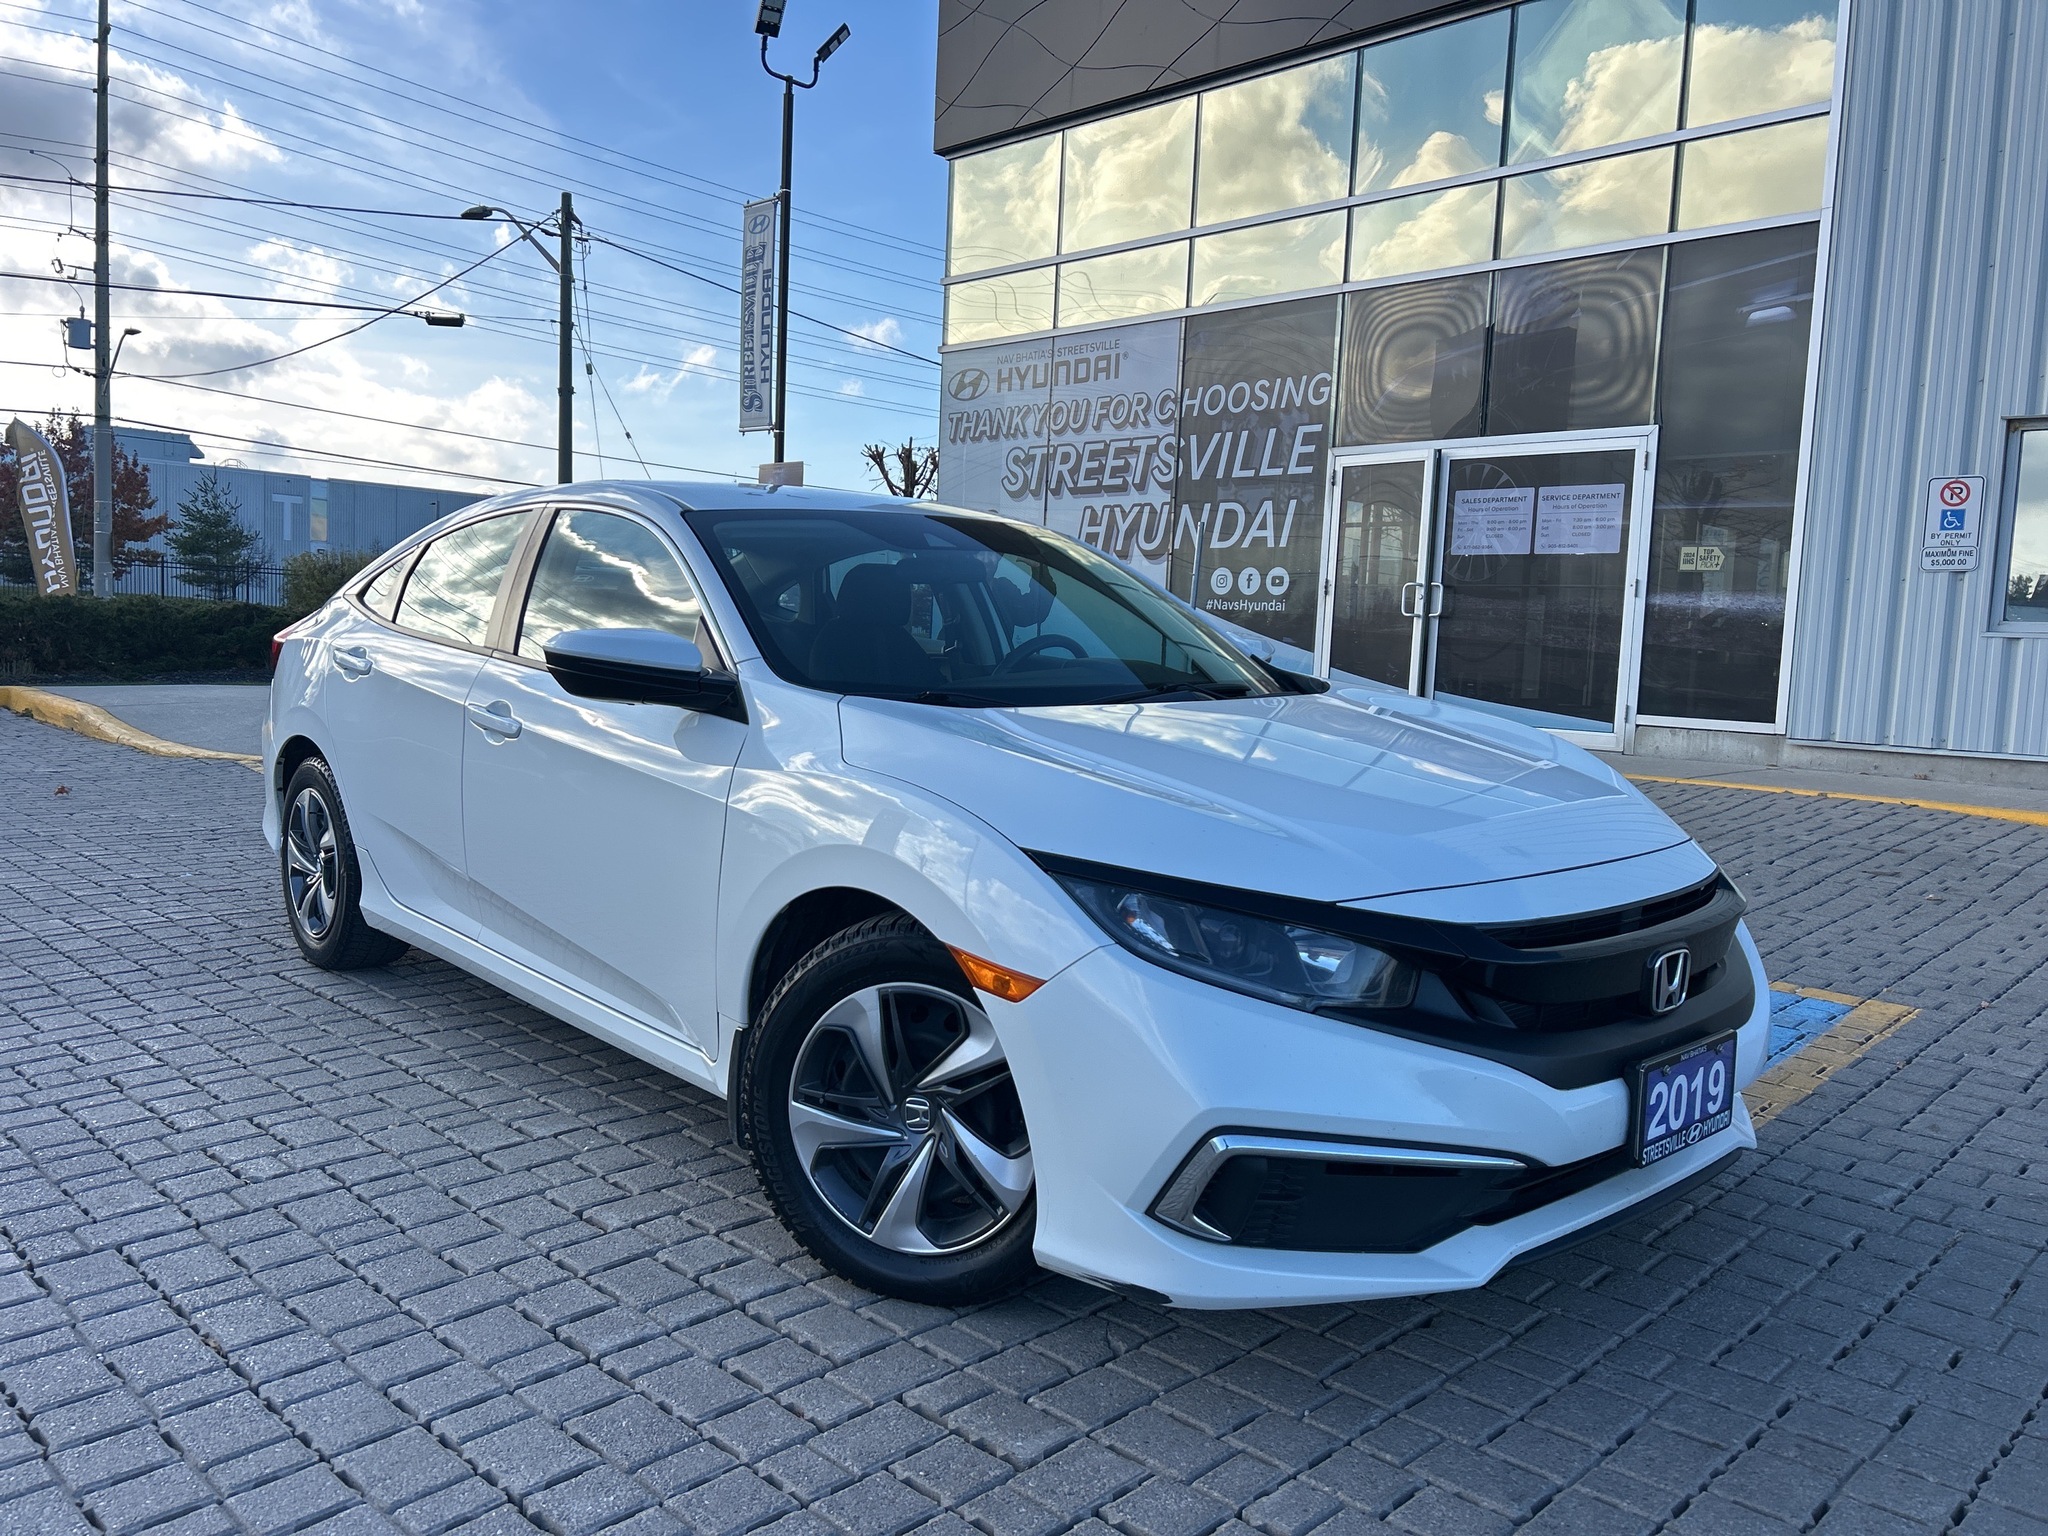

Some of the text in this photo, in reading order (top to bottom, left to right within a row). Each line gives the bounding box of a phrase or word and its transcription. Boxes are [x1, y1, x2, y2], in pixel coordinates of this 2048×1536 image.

[760, 268, 772, 383] HYUNDAI
[996, 353, 1120, 393] HYUNDAI
[997, 339, 1120, 365] NAV BHATIA'S STREETSVILLE
[947, 372, 1332, 443] THANK YOU FOR CHOOSING
[1001, 423, 1323, 496] STREETSVILLE
[1483, 495, 1528, 503] DEPARTMENT
[1572, 492, 1621, 500] DEPARTMENT
[1080, 499, 1298, 557] HYUNDAI
[1925, 549, 1974, 558] MAXIMUM FINE
[1206, 598, 1286, 613] #NavsHyundai
[1647, 1060, 1725, 1140] 2019
[1642, 1109, 1731, 1165] STREETSVILLE HYUNDAI
